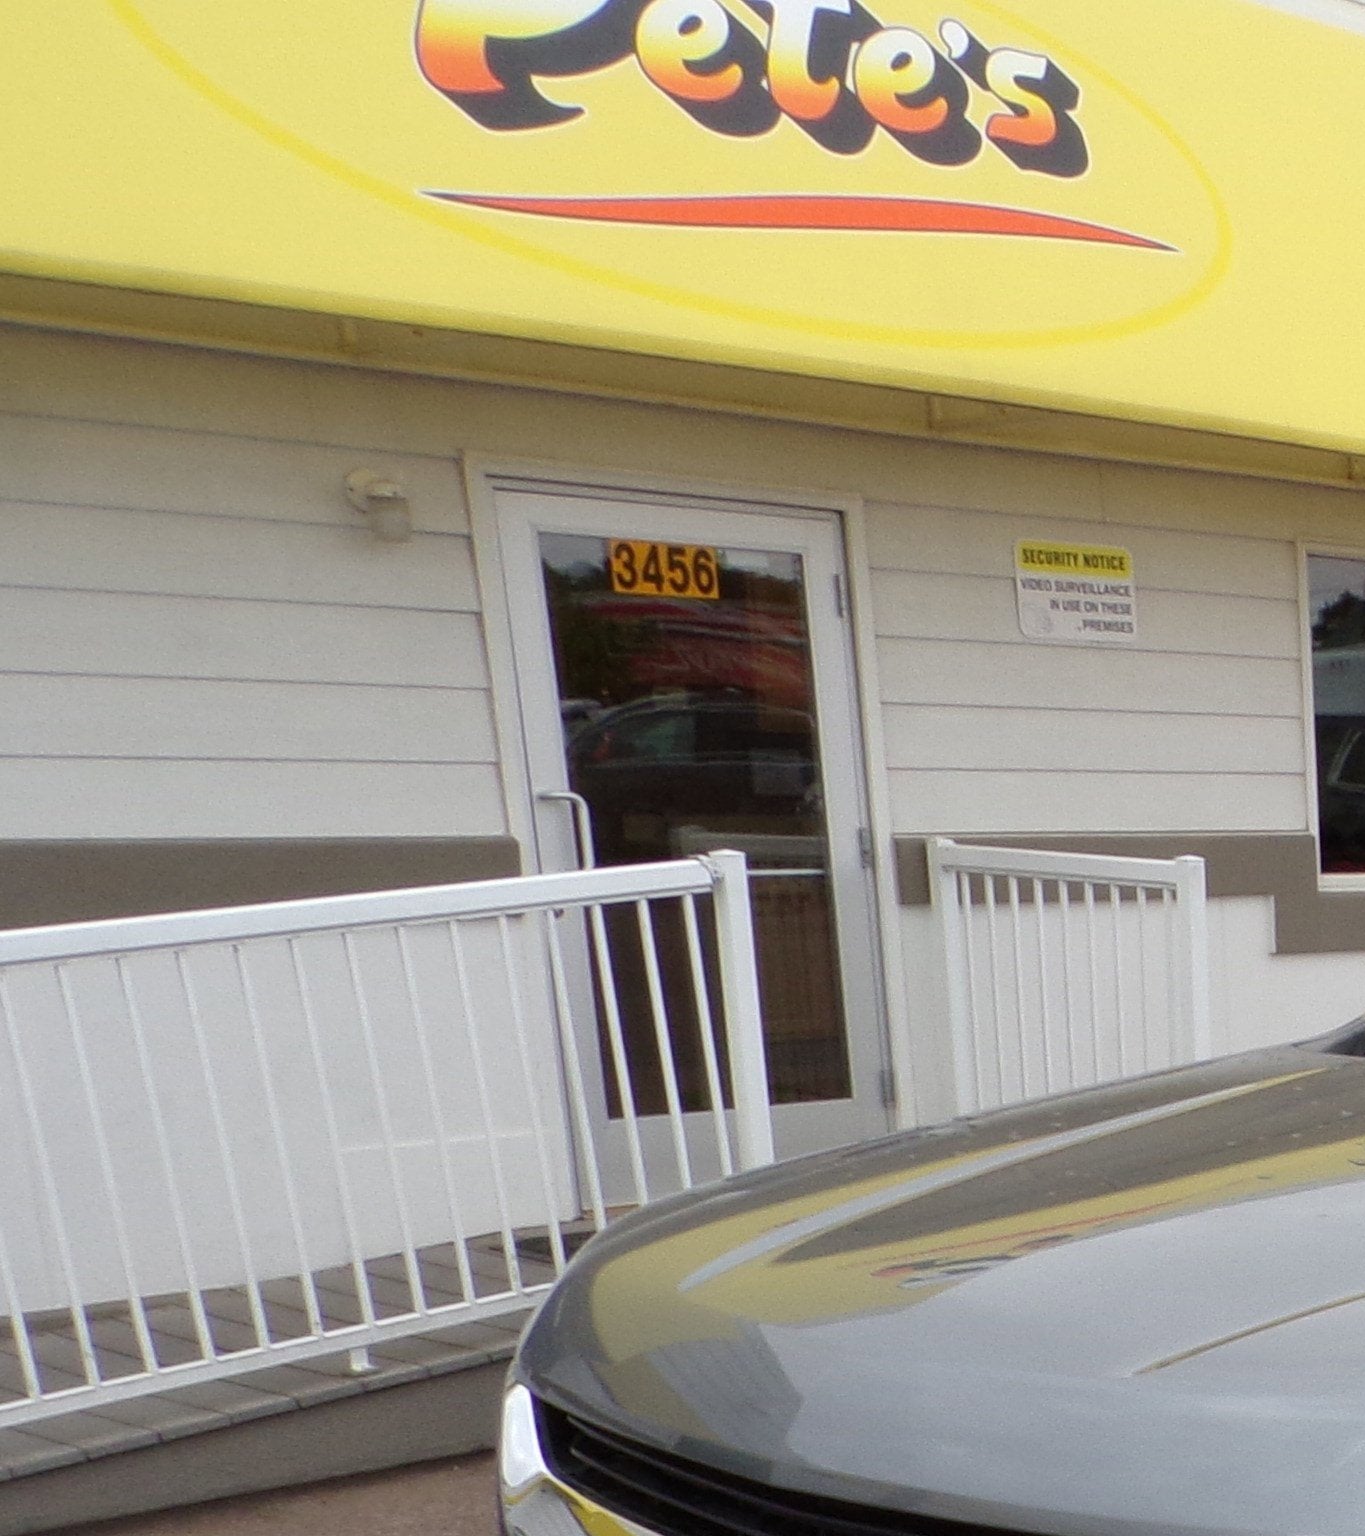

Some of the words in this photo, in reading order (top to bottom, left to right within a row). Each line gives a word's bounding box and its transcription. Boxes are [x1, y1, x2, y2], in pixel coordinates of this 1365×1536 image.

[614, 543, 715, 595] 3456
[1022, 548, 1079, 567] SECURITY
[1082, 553, 1126, 571] NOTICE
[1020, 578, 1053, 592] VIDEO
[1054, 580, 1133, 597] SURVEILLANCE
[1050, 599, 1060, 610] IN
[1062, 600, 1080, 612] USE
[1083, 601, 1099, 613] ON
[1101, 602, 1132, 615] THESE
[1082, 619, 1134, 633] PREMISES
